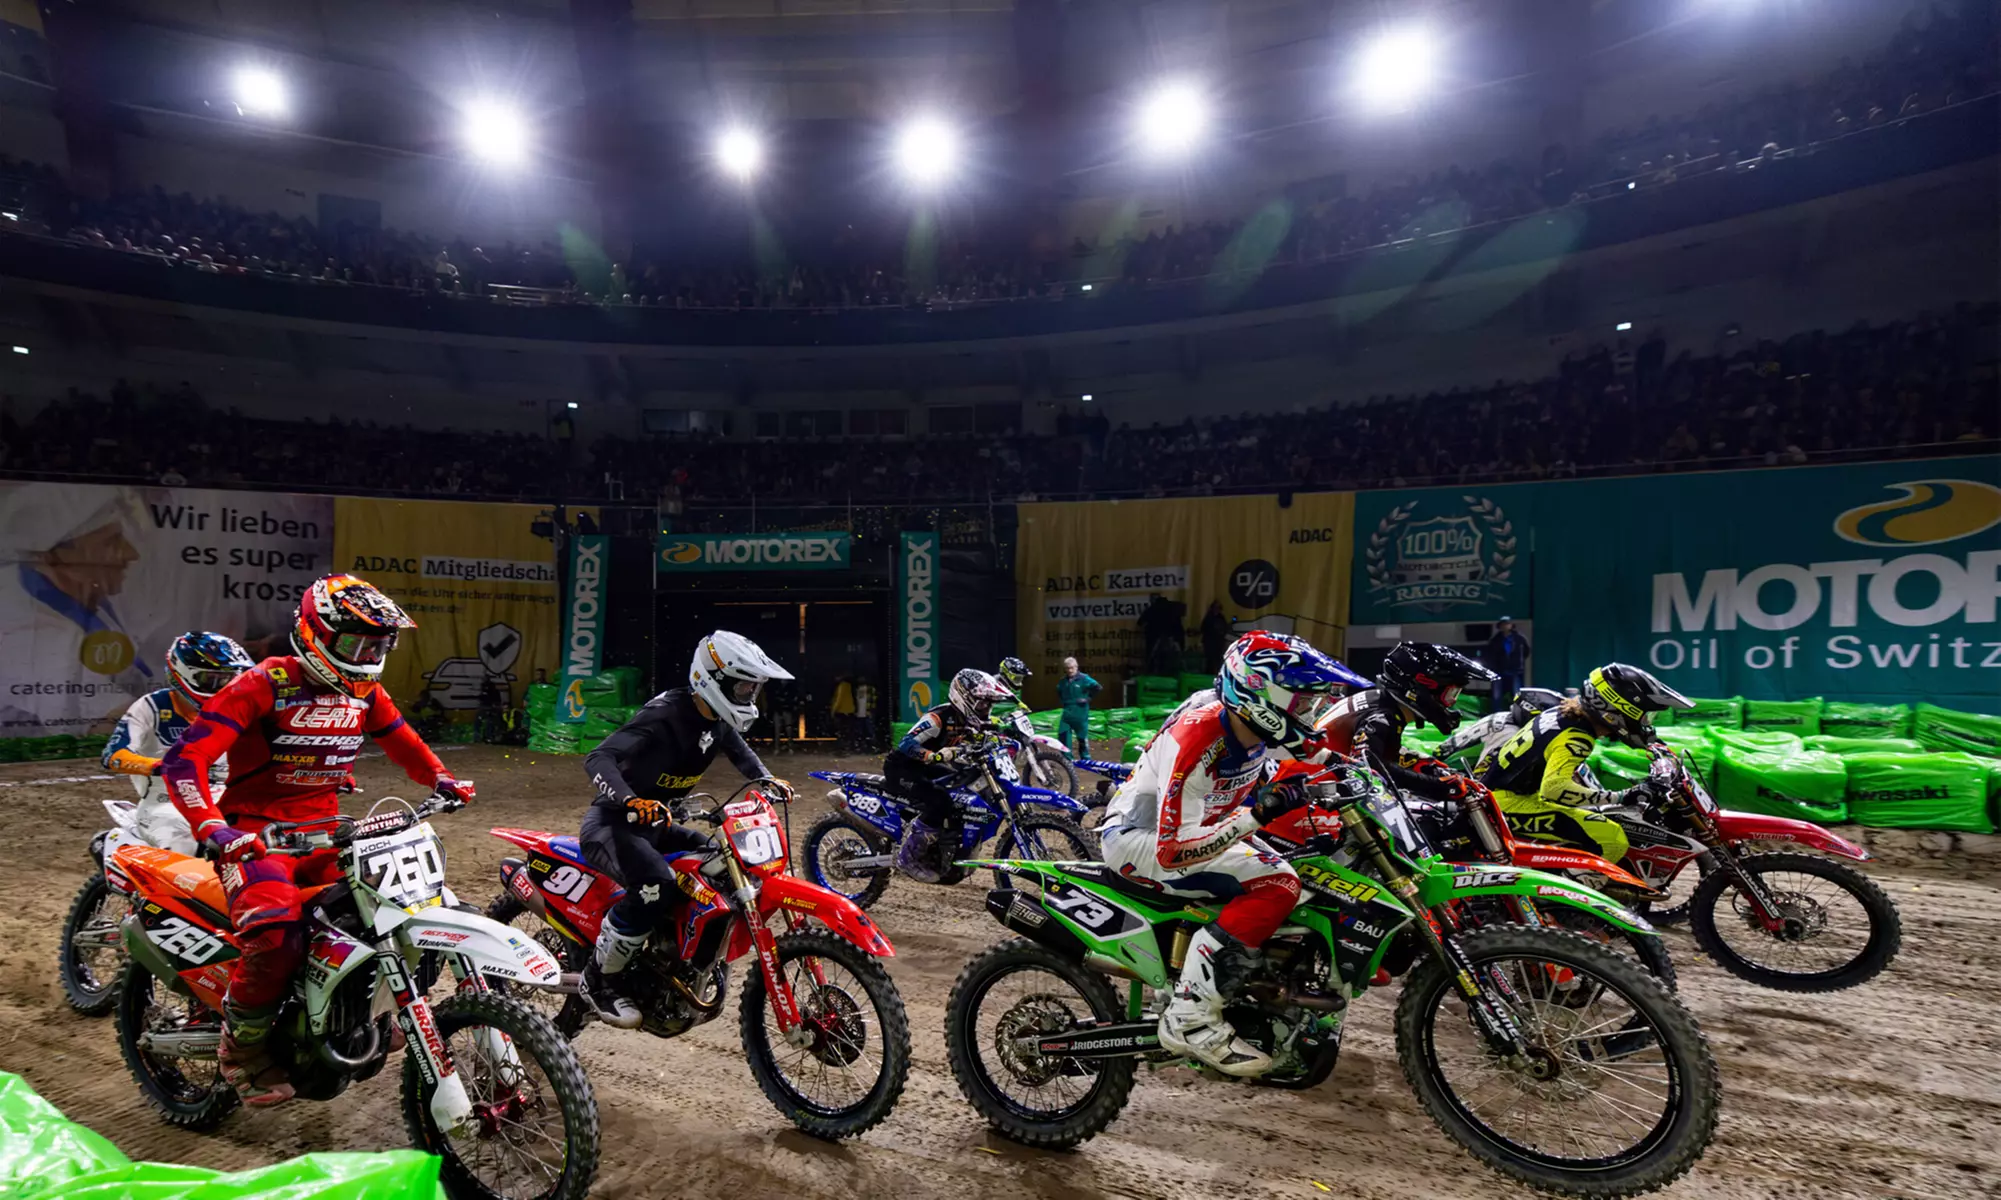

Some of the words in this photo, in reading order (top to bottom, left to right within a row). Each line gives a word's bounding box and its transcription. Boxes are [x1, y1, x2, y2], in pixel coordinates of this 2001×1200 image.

[151, 504, 211, 530] Wir
[221, 507, 319, 539] lieben
[1289, 528, 1333, 543] ADAC
[1404, 528, 1473, 555] 100%
[181, 546, 219, 565] es
[229, 547, 319, 573] super
[352, 555, 417, 573] ADAC
[704, 537, 842, 564] MOTOREX
[1046, 574, 1101, 592] ADAC
[1108, 572, 1185, 590] Karten-
[1396, 584, 1481, 601] RACING
[567, 541, 601, 676] MOTOREX
[906, 538, 932, 679] MOTOREX
[1049, 600, 1149, 619] vorverkau
[1650, 638, 1718, 669] Oil
[1744, 636, 1800, 669] of
[1256, 709, 1280, 728] Arai
[848, 792, 882, 815] 389
[359, 840, 392, 854] KOCH
[744, 825, 784, 864] 91
[367, 840, 444, 902] 260
[541, 865, 596, 904] 91
[1296, 862, 1380, 903] pfeil
[1020, 907, 1044, 925] HGS
[1055, 888, 1115, 928] 73
[145, 917, 225, 965] 260
[1353, 919, 1385, 939] BAU
[480, 964, 518, 977] MAXXIS
[761, 950, 792, 1017] DUNLOP
[1070, 1036, 1134, 1051] BRIDGESTONE
[406, 1033, 436, 1085] Silkolene
